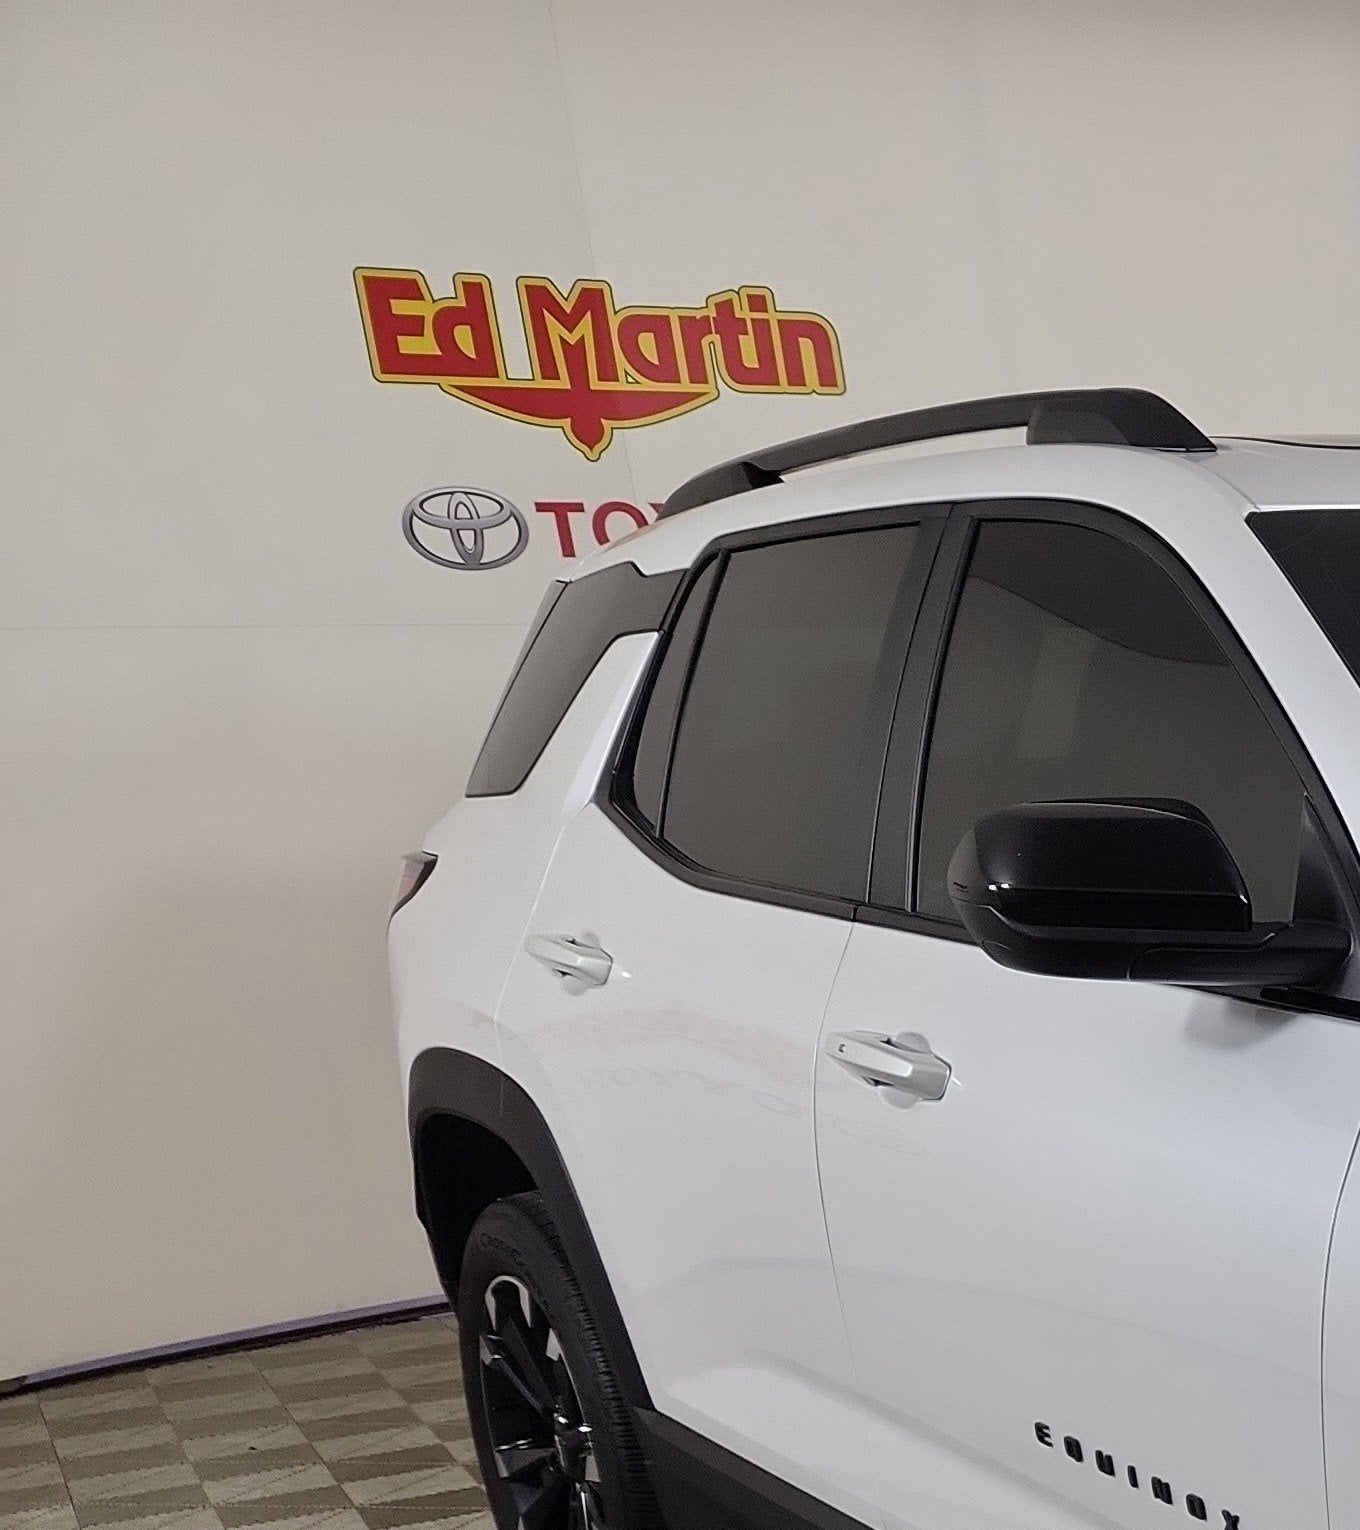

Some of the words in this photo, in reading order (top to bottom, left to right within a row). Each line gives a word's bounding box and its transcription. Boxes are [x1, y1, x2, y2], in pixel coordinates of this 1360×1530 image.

[362, 274, 499, 379] Ed
[524, 282, 839, 389] Martin
[534, 501, 666, 558] TO
